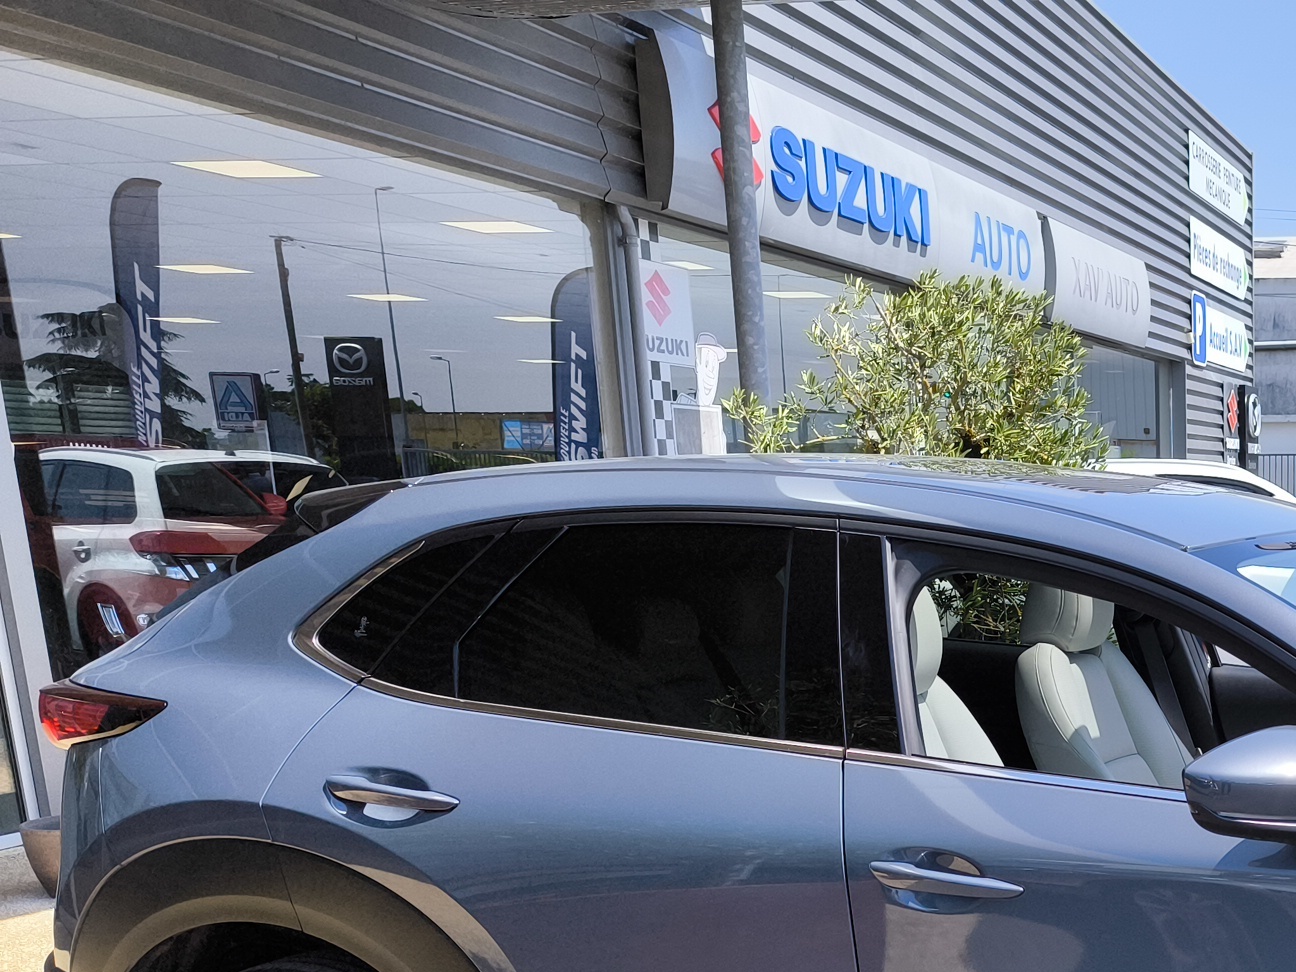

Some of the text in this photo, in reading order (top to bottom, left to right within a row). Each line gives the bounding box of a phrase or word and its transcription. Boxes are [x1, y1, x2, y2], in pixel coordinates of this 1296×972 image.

[770, 125, 1031, 282] SUZUKI AUTO
[1212, 244, 1219, 272] de
[1220, 252, 1242, 290] rechange
[133, 262, 163, 448] SWIFT
[645, 334, 690, 357] UZUKI
[1195, 301, 1204, 355] P
[1209, 322, 1228, 354] Accueil
[131, 363, 148, 446] NOUVELLE
[570, 331, 588, 461] SWIFT
